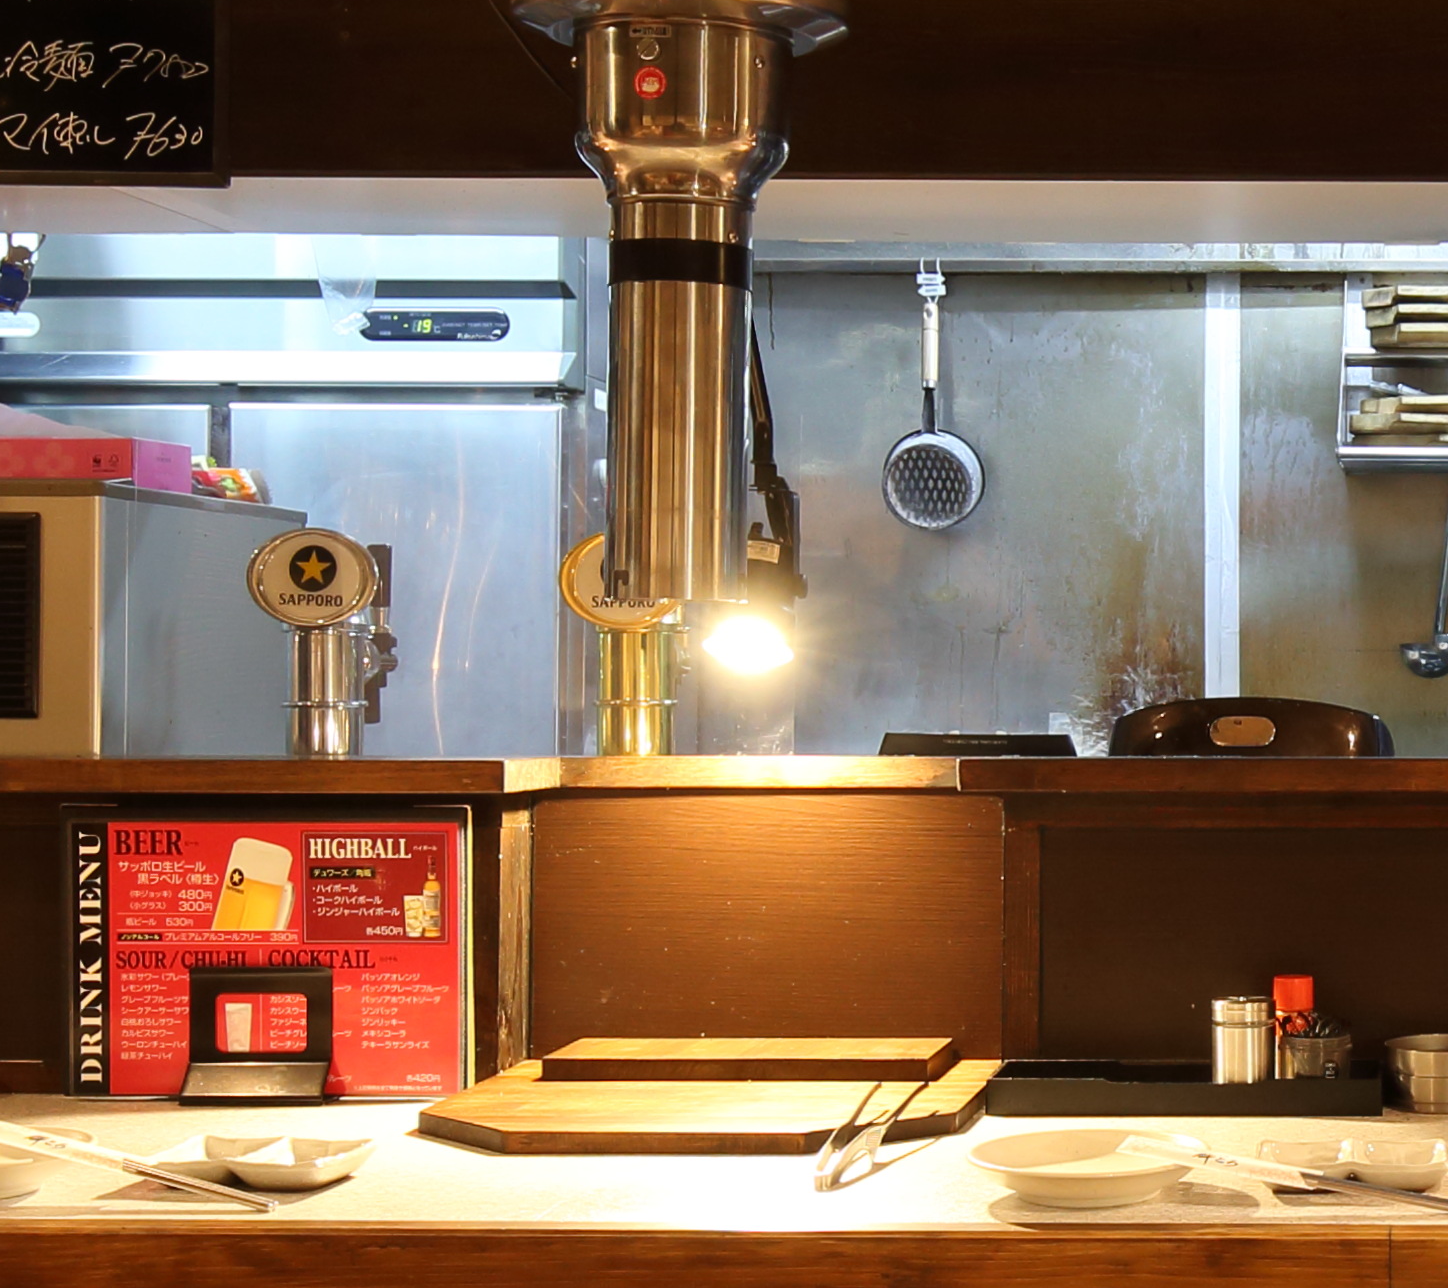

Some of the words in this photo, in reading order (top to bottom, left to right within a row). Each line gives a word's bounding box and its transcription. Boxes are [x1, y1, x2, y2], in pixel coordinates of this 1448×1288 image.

[278, 592, 343, 608] SAPPORO
[114, 829, 184, 856] BEER
[309, 838, 412, 860] HIGHBALL
[118, 860, 206, 873] サッポロ生ビール
[78, 831, 102, 945] MENU
[178, 889, 213, 901] 480円
[178, 901, 213, 912] 300円
[166, 917, 194, 927] 530円
[164, 932, 262, 942] プレミアムアルコールフリー
[269, 932, 298, 942] 390円
[268, 949, 376, 969] COCKTAIL
[121, 984, 167, 993] レモンサワー
[79, 957, 103, 1084] DRINK
